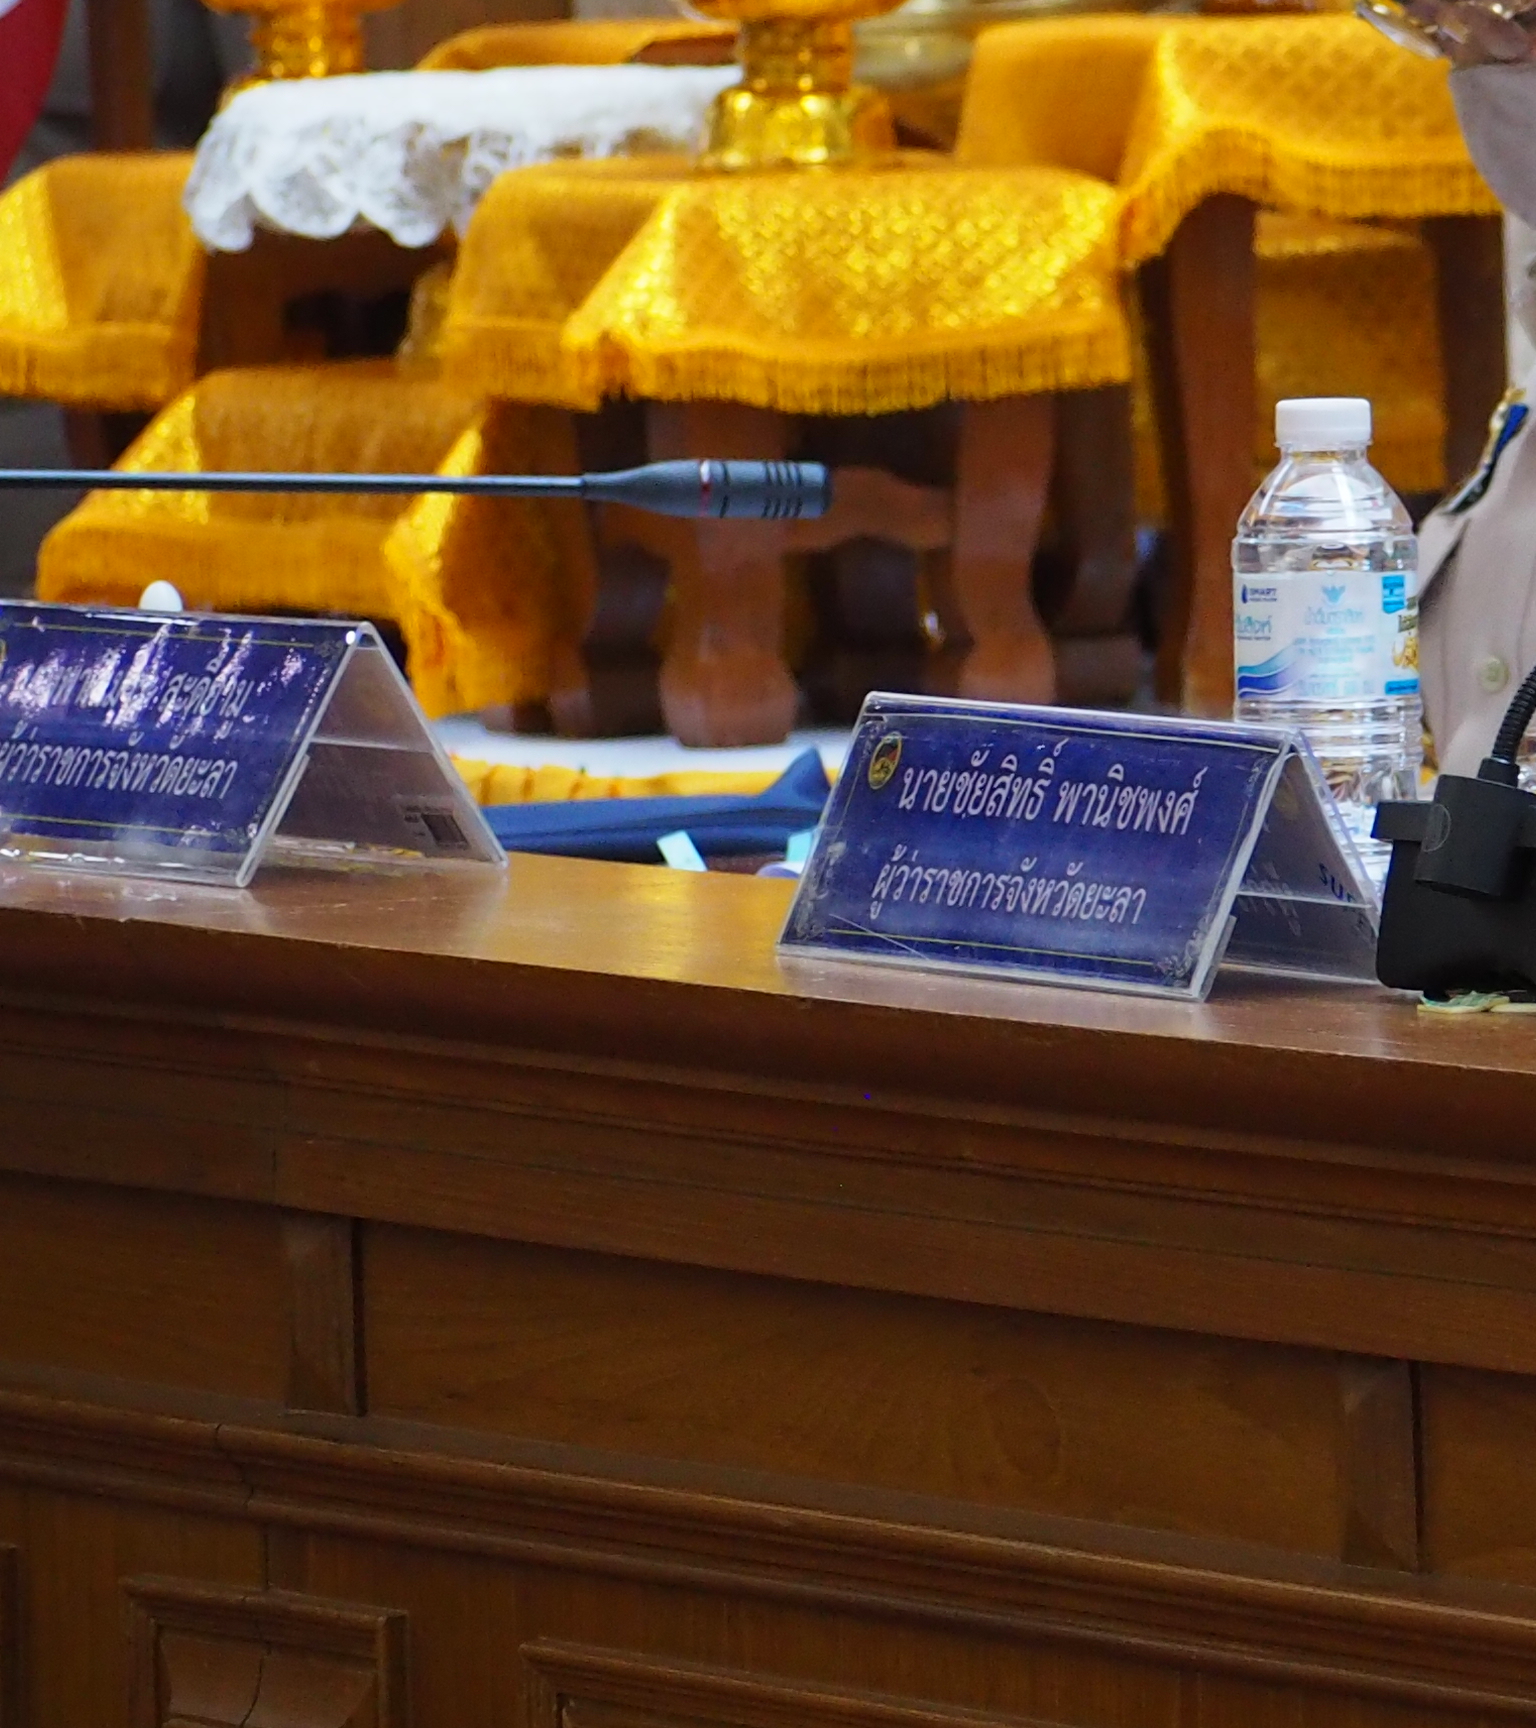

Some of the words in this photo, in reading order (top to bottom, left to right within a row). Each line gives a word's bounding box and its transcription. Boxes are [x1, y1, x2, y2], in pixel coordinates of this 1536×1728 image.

[899, 738, 1069, 821] นายชัยสิทธิ์
[1053, 763, 1209, 835] พานิชพงศ์
[869, 843, 1147, 925] ผู้ว่าราชการจังหวัดยะลา
